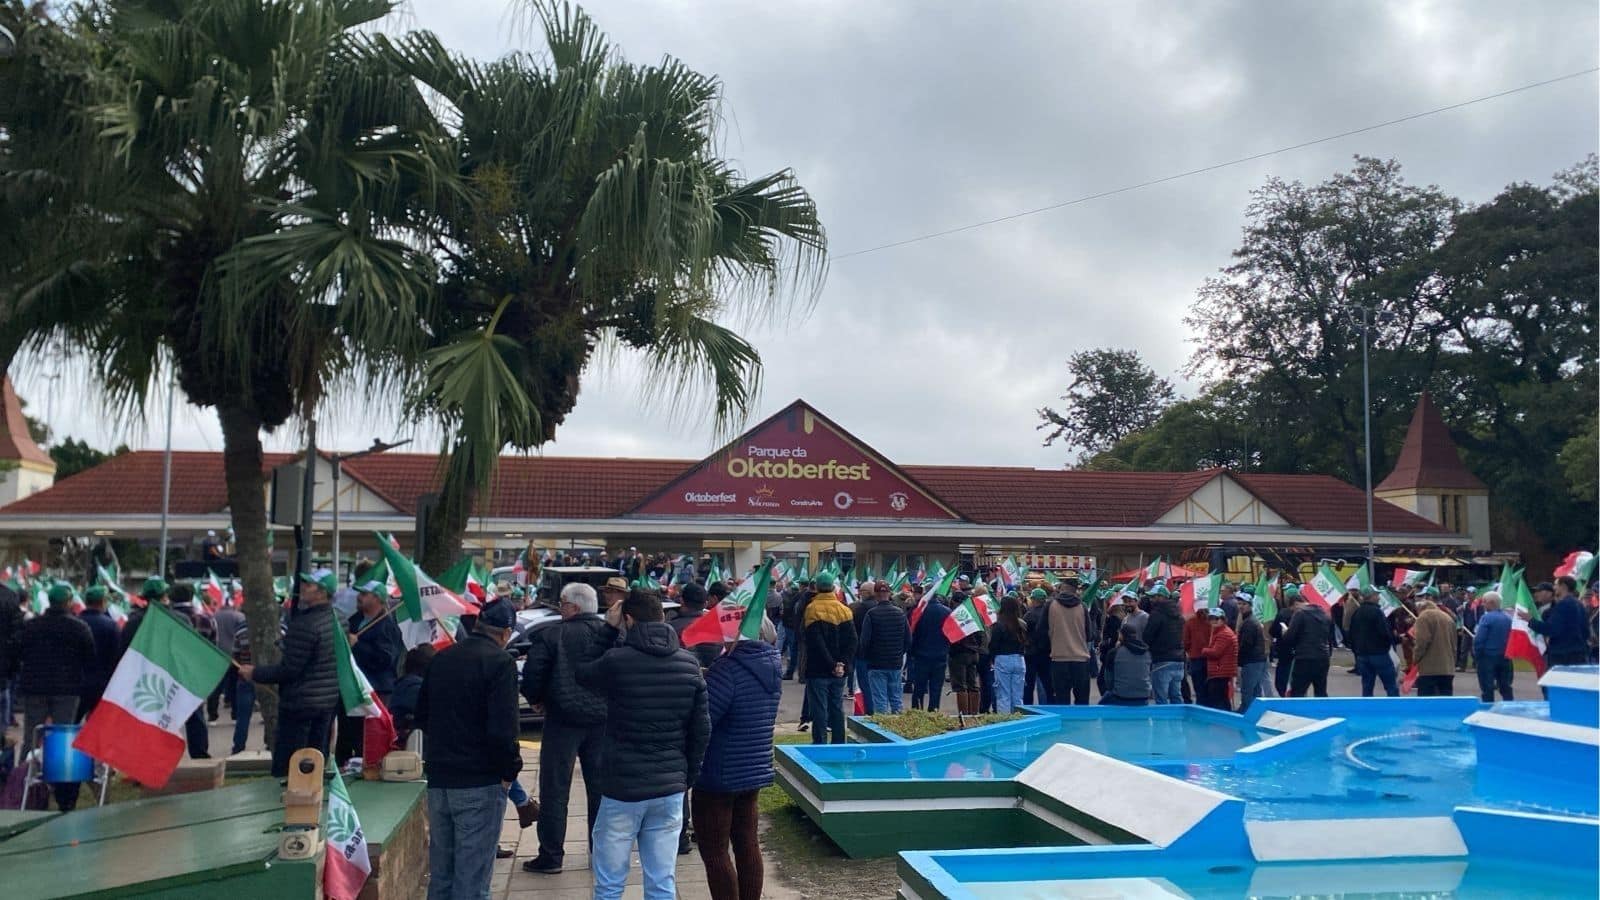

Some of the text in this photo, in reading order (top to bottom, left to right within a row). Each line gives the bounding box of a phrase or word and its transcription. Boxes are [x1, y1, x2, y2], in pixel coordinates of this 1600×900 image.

[747, 445, 807, 459] Parque da
[727, 457, 871, 480] Oktoberfest
[685, 492, 736, 502] Oktoberfest
